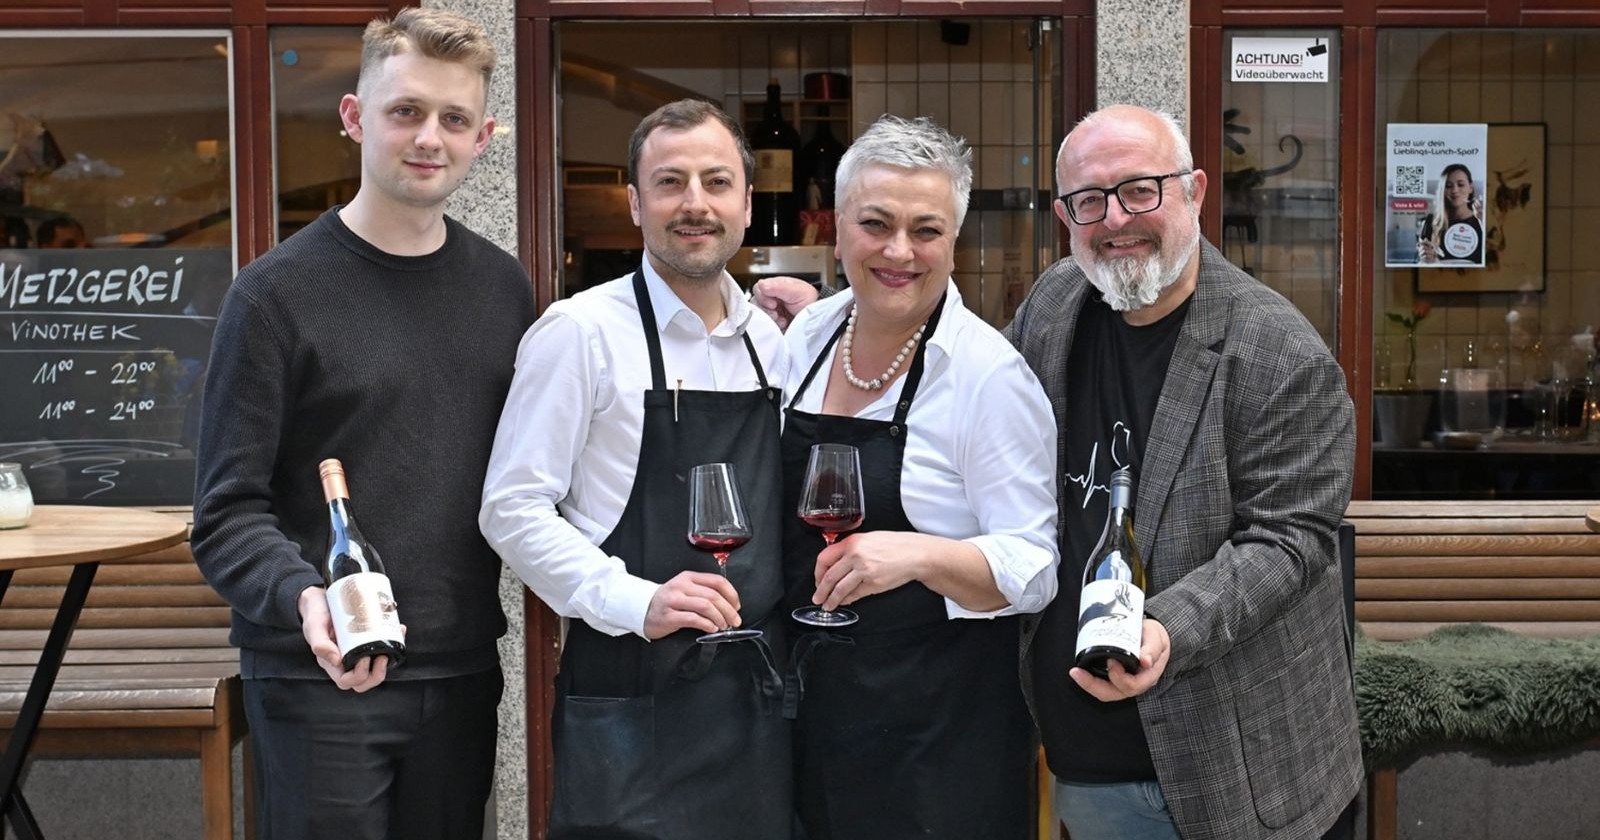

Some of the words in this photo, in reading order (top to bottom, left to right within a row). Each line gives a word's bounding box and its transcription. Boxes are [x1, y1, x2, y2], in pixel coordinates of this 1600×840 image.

[1236, 53, 1303, 65] ACHTUNG!
[1235, 69, 1324, 80] Videoüberwacht
[1393, 139, 1411, 147] Sind
[1427, 139, 1445, 147] dein
[1393, 147, 1479, 156] Lieblings-Lunch-Spot?
